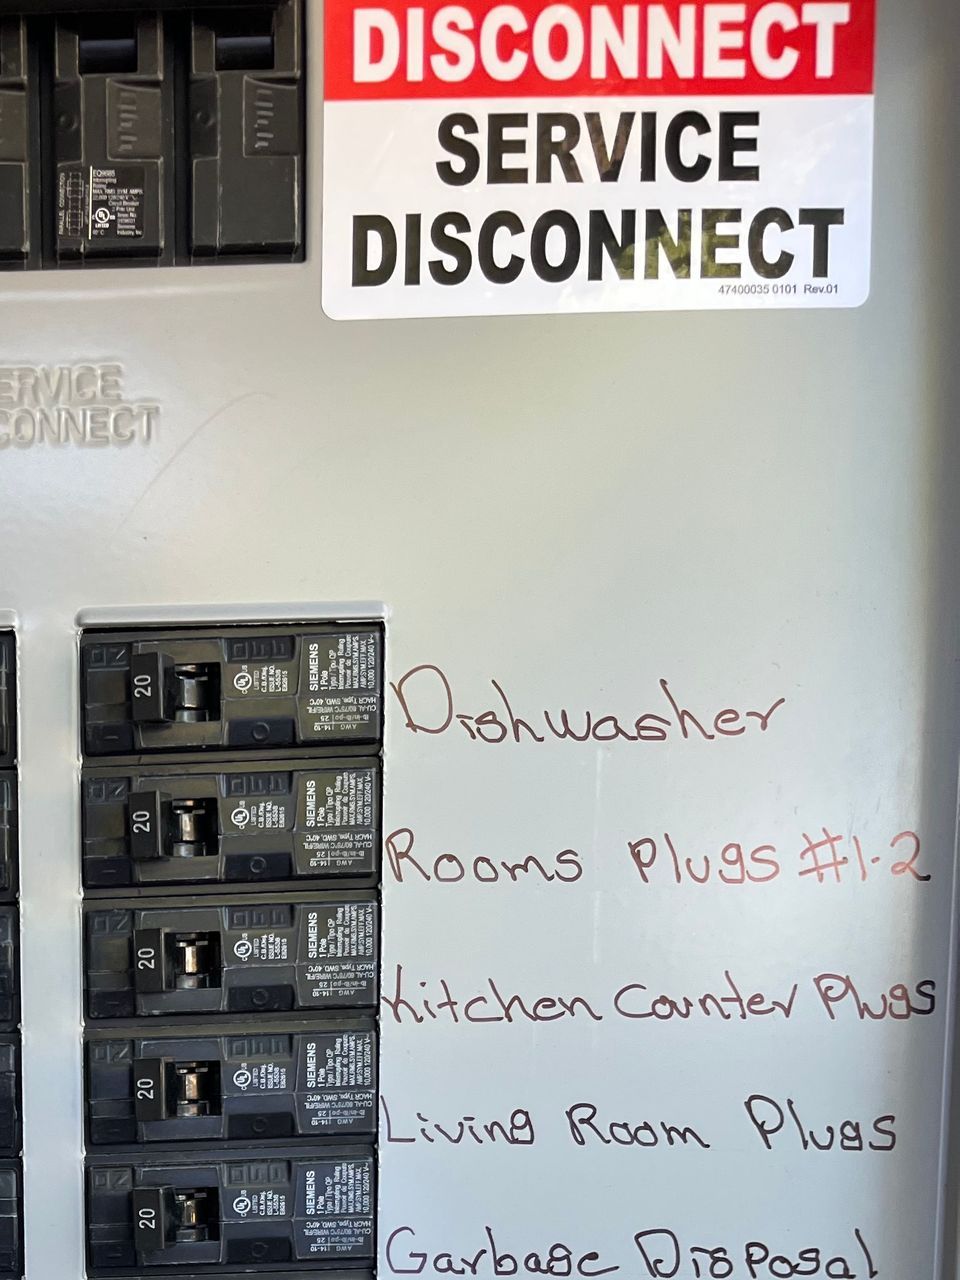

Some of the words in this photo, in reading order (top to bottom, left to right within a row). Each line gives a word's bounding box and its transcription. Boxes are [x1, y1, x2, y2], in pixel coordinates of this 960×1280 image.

[352, 3, 850, 83] DISCONNECT
[436, 110, 760, 186] SERVICE
[351, 207, 845, 288] DISCONNECT
[718, 284, 768, 296] 47400035
[771, 284, 797, 295] 0101
[803, 283, 839, 295] Rev.01
[134, 674, 152, 698] 20
[309, 643, 319, 691] SIEMENS
[389, 664, 785, 744] Dishwasher
[133, 811, 150, 833] 20
[306, 780, 315, 827] SIEMENS
[386, 828, 583, 884] Rooms
[628, 832, 780, 885] Plugs
[138, 948, 155, 969] 20
[308, 912, 317, 958] SIEMENS
[381, 964, 604, 1024] Kitchen
[613, 970, 797, 1021] Counter
[812, 973, 936, 1021] Plugs
[307, 1042, 316, 1088] SIEMENS
[137, 1079, 154, 1099] 20
[380, 1094, 536, 1146] Living
[565, 1101, 711, 1150] Room
[744, 1094, 897, 1153] Plugs
[305, 1170, 315, 1215] SIEMENS
[139, 1208, 155, 1229] 20
[385, 1226, 620, 1278] Garbage
